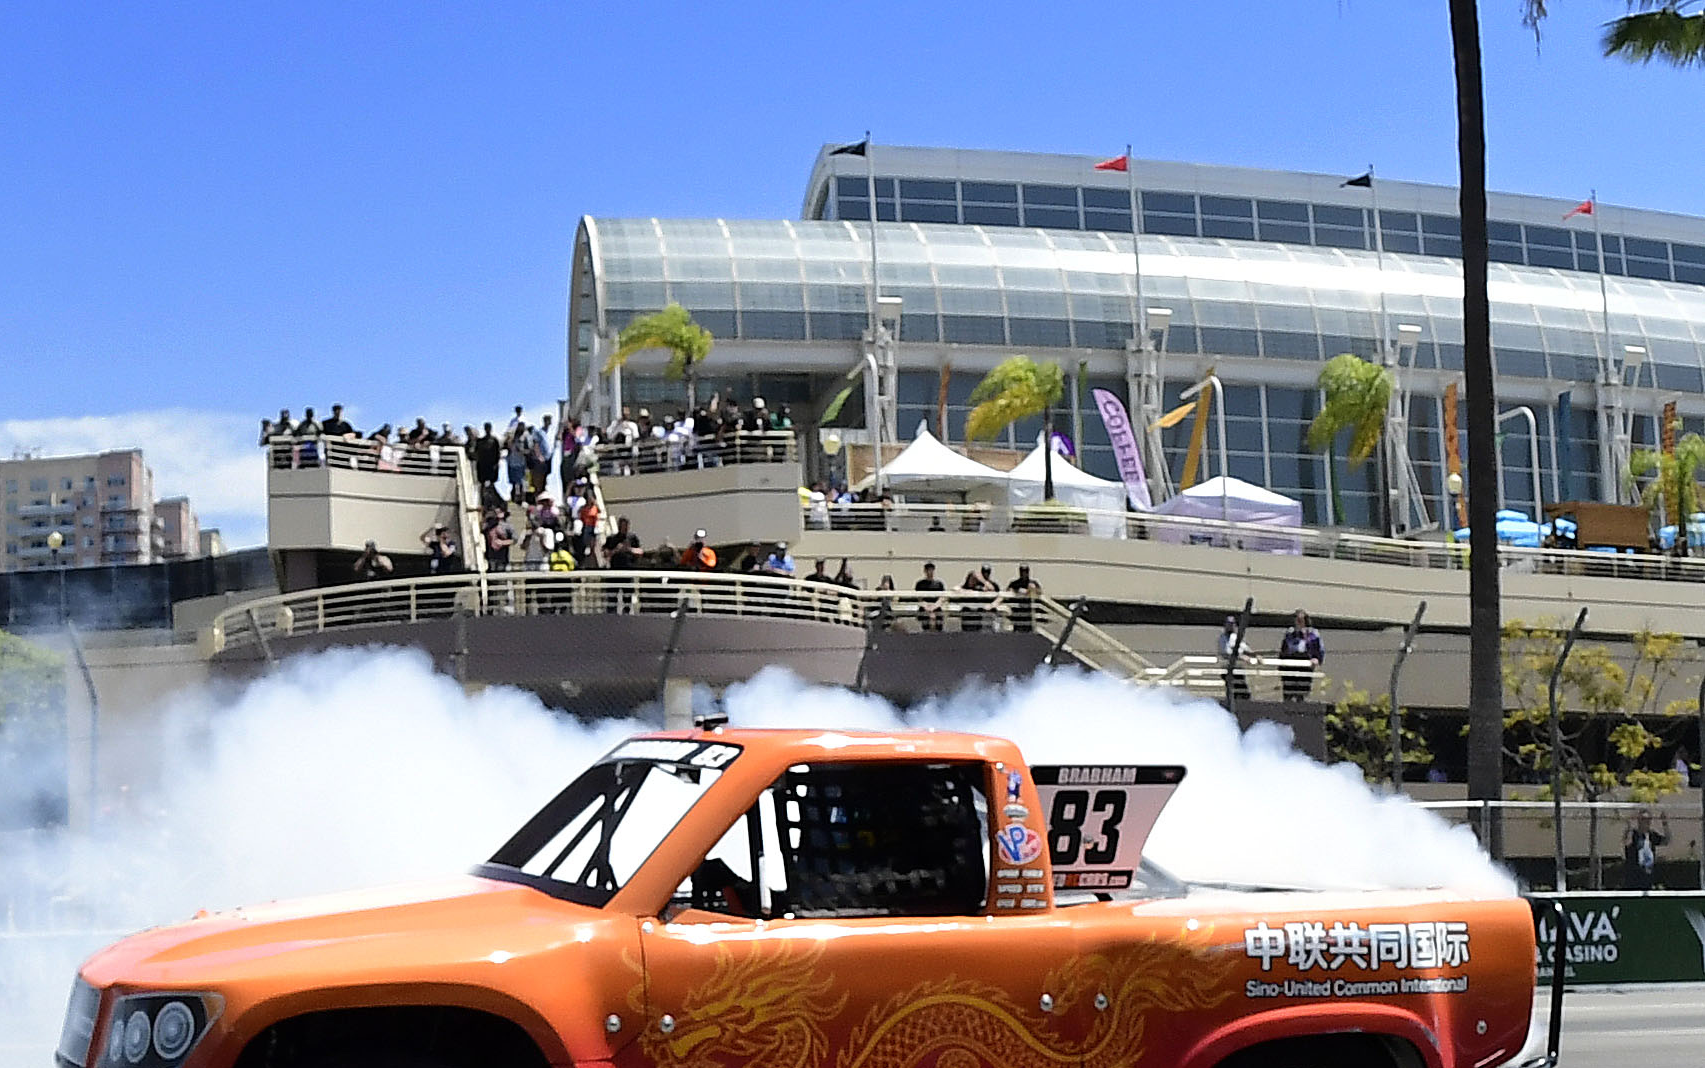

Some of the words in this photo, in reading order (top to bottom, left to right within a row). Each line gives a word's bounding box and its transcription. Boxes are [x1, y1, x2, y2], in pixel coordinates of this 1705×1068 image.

[1103, 400, 1141, 482] COFFEE
[1057, 766, 1137, 785] BRABHAM
[1046, 790, 1128, 865] 83
[1244, 921, 1471, 971] 中联共同国际
[1245, 979, 1331, 998] Sino-United
[1333, 979, 1398, 996] Common
